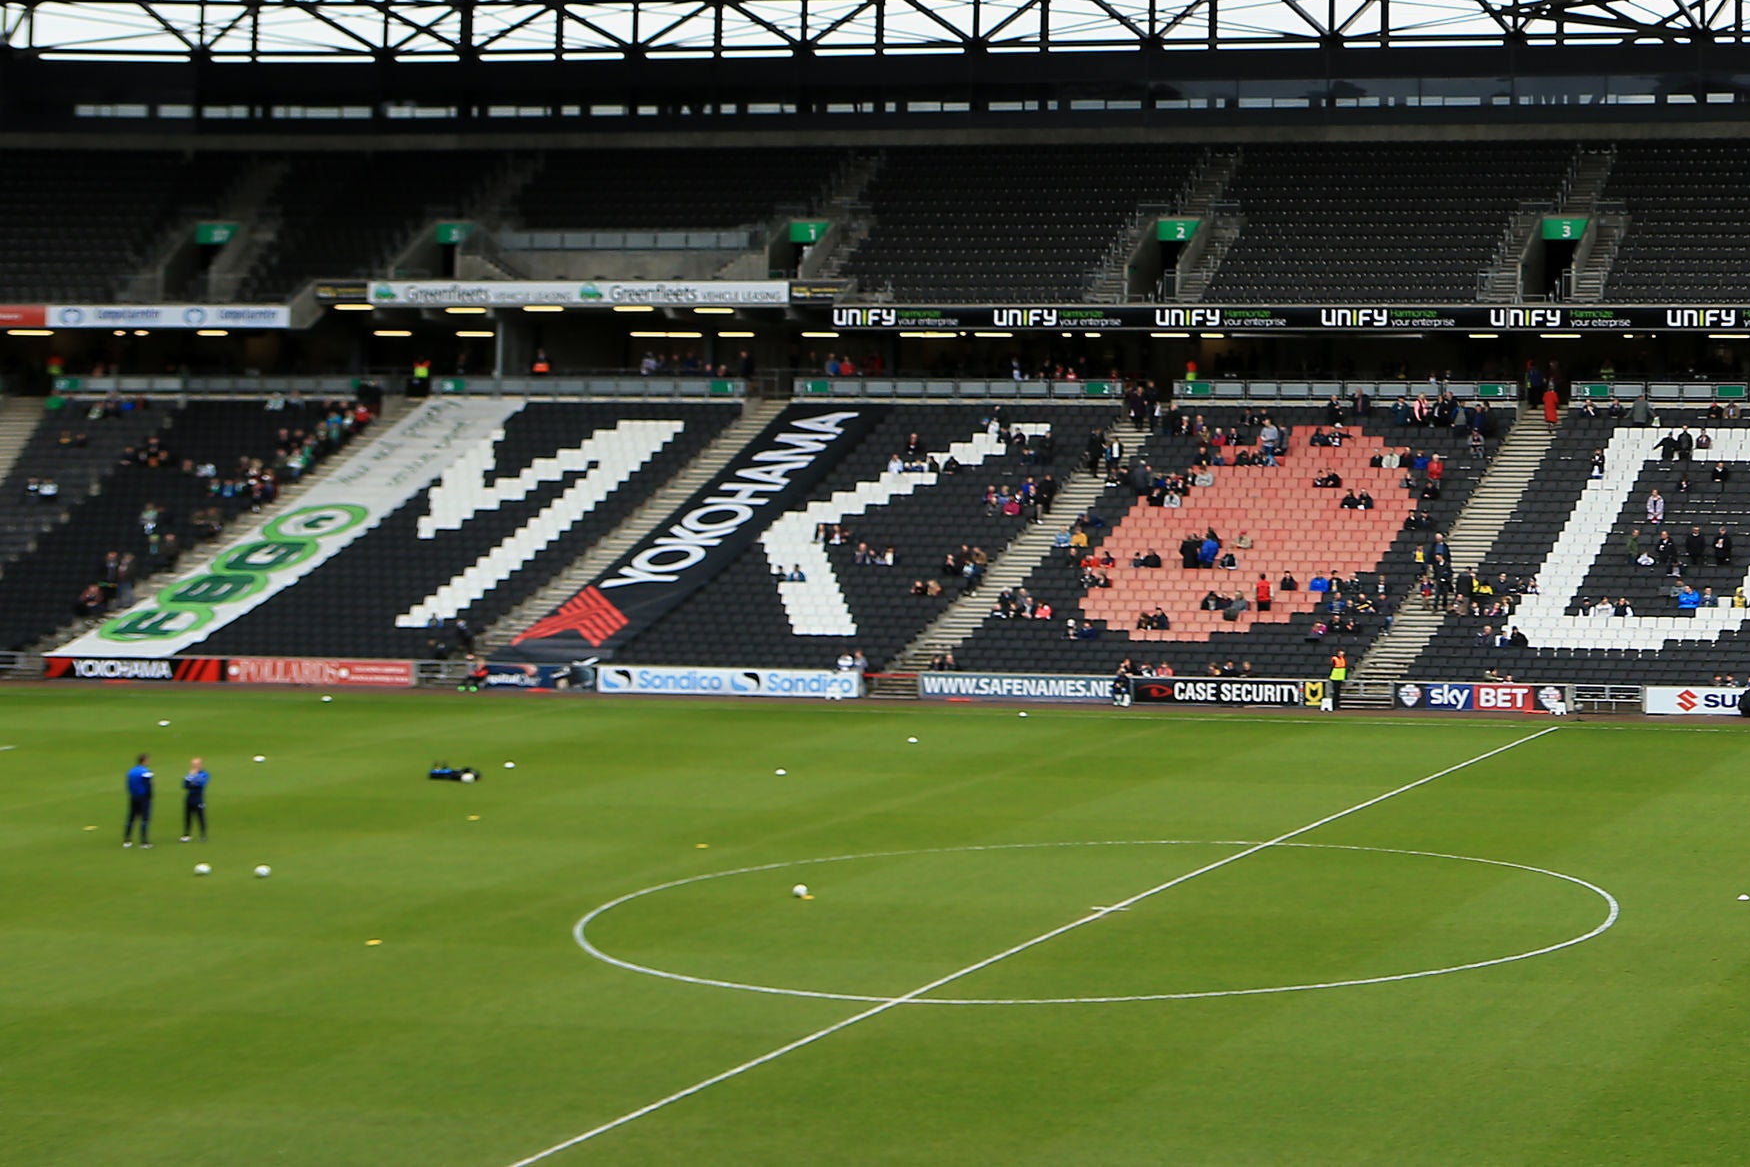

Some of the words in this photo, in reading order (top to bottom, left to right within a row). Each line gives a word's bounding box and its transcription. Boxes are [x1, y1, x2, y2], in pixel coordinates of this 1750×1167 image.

[809, 229, 817, 241] 1
[1176, 227, 1185, 239] 2
[1562, 226, 1571, 238] 3
[898, 319, 917, 328] your
[1059, 319, 1078, 328] your
[1080, 318, 1122, 328] enterprise
[1223, 319, 1242, 328] your
[1244, 318, 1287, 328] enterprise
[1391, 319, 1410, 328] your
[1412, 318, 1455, 328] enterprise
[1571, 319, 1590, 328] your
[1102, 385, 1109, 394] 2
[1186, 384, 1192, 394] 2
[1497, 387, 1503, 396] 3
[1584, 387, 1590, 396] 3
[600, 411, 860, 589] YOKOHAMA
[72, 659, 172, 680] YOKOHAMA
[638, 670, 722, 690] Sondico
[923, 676, 1114, 697] WWW.SAFENAMES.NE
[1173, 682, 1217, 701] CASE
[1220, 682, 1299, 703] SECURITY
[1430, 684, 1470, 710] sky
[1479, 688, 1529, 708] BET
